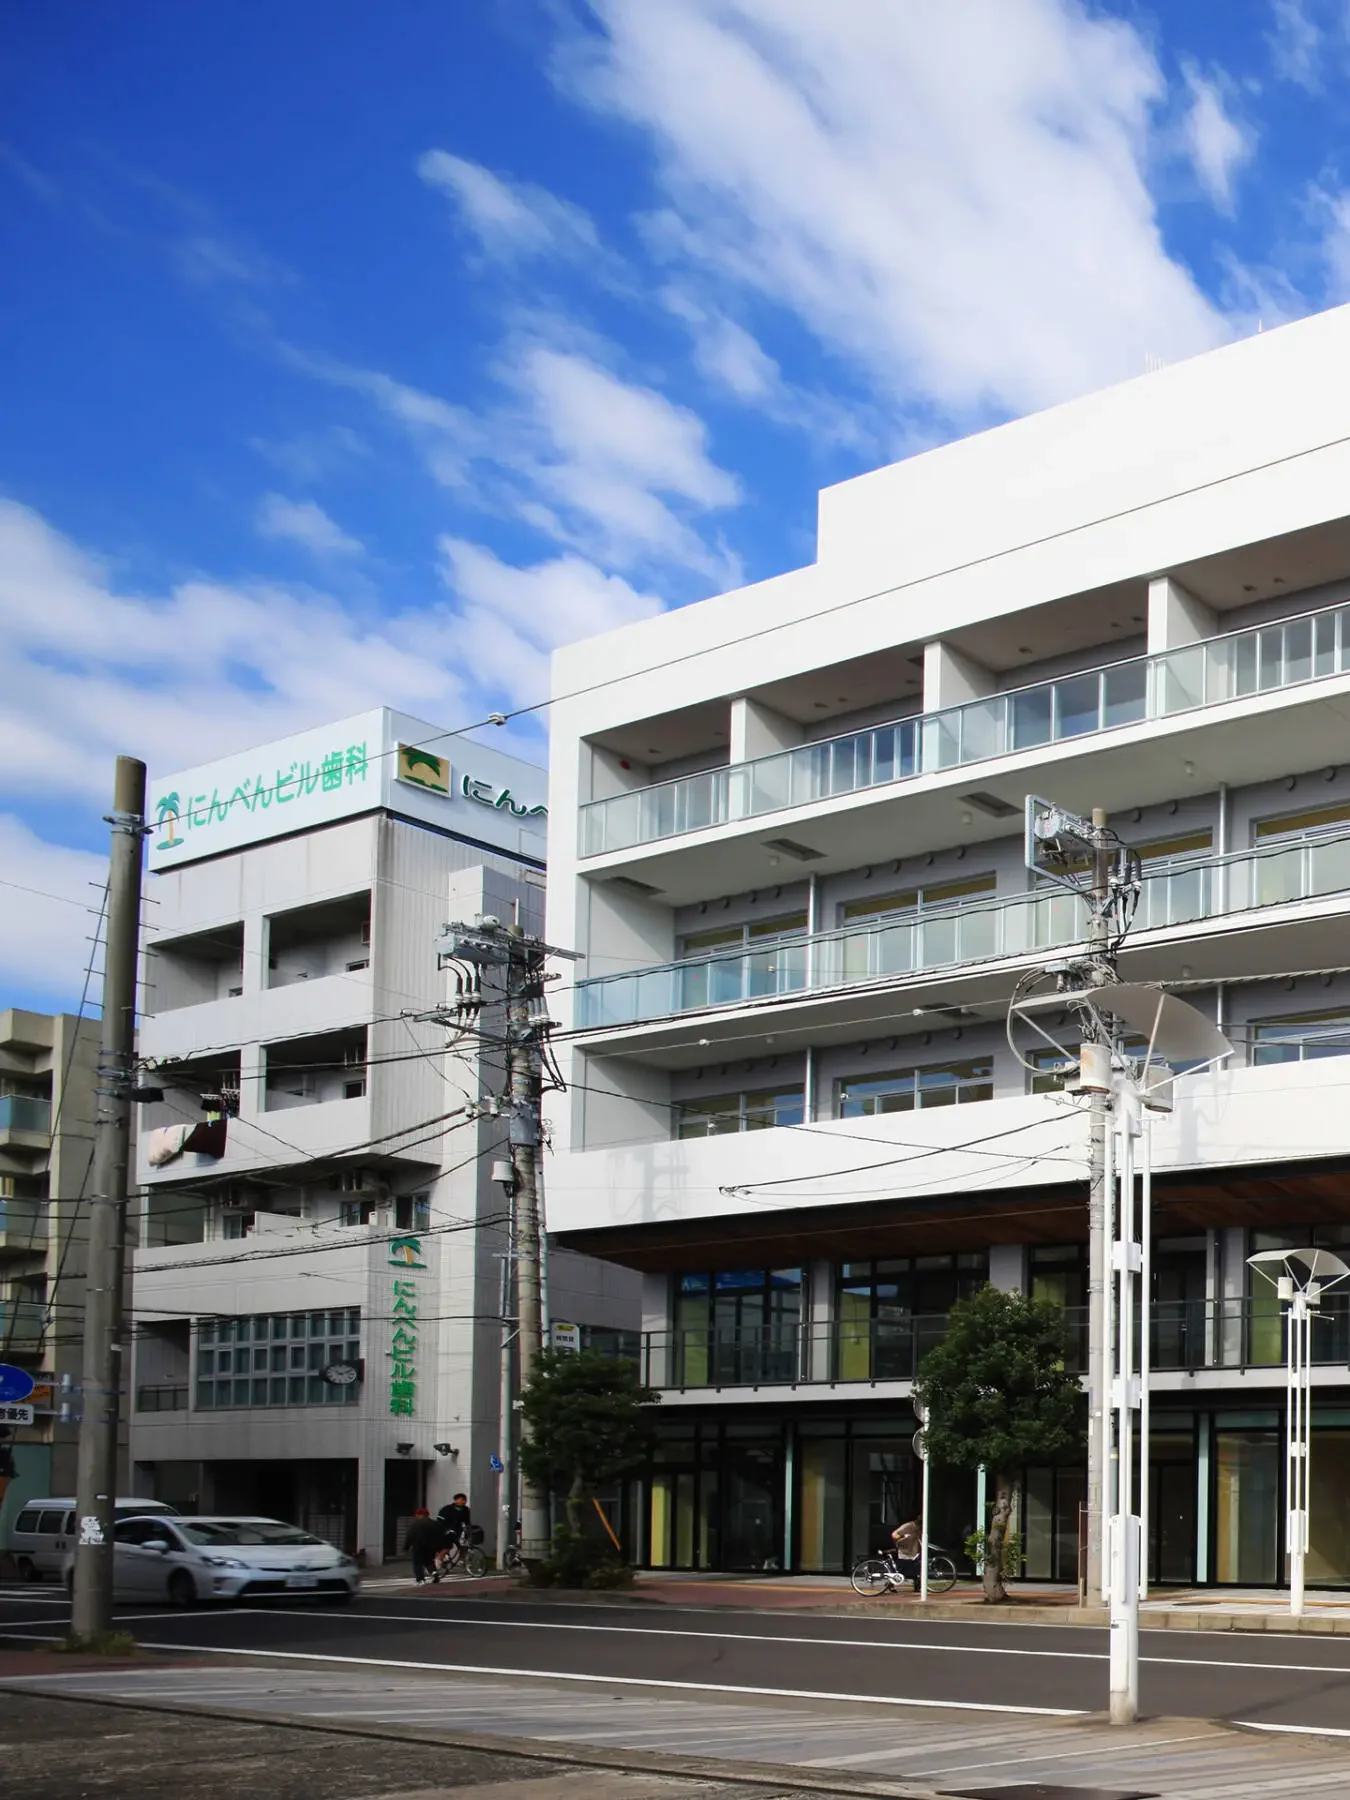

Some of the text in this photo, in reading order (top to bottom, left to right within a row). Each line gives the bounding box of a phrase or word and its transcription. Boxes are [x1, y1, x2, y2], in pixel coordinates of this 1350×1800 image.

[187, 741, 369, 830] にんべんビル歯科
